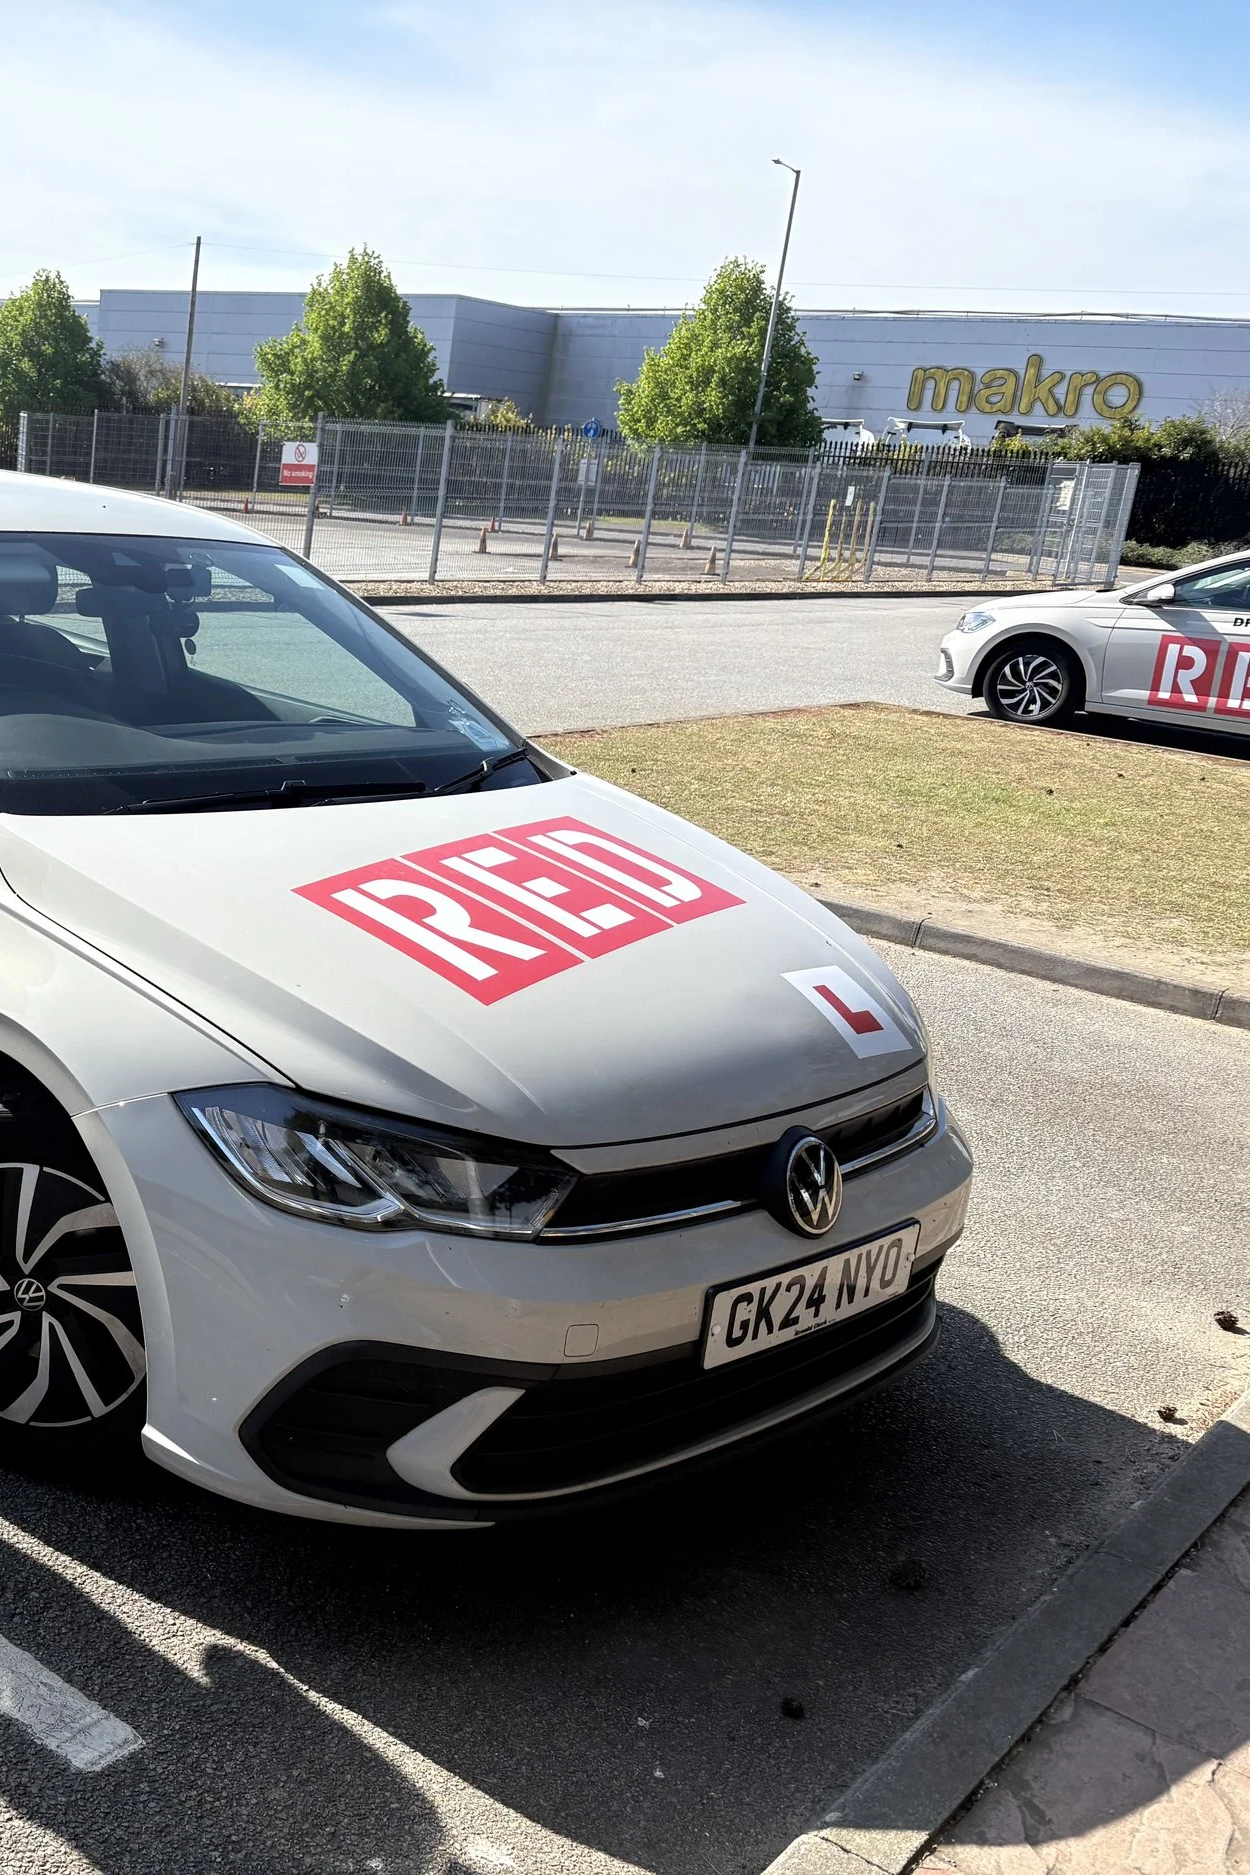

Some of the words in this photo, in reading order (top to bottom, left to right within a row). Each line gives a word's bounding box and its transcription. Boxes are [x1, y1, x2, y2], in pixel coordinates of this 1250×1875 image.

[907, 354, 1142, 419] makro
[292, 470, 314, 479] smoking
[326, 827, 704, 983] RED
[812, 984, 885, 1035] L
[725, 1265, 829, 1349] GK24
[835, 1237, 903, 1311] NYO
